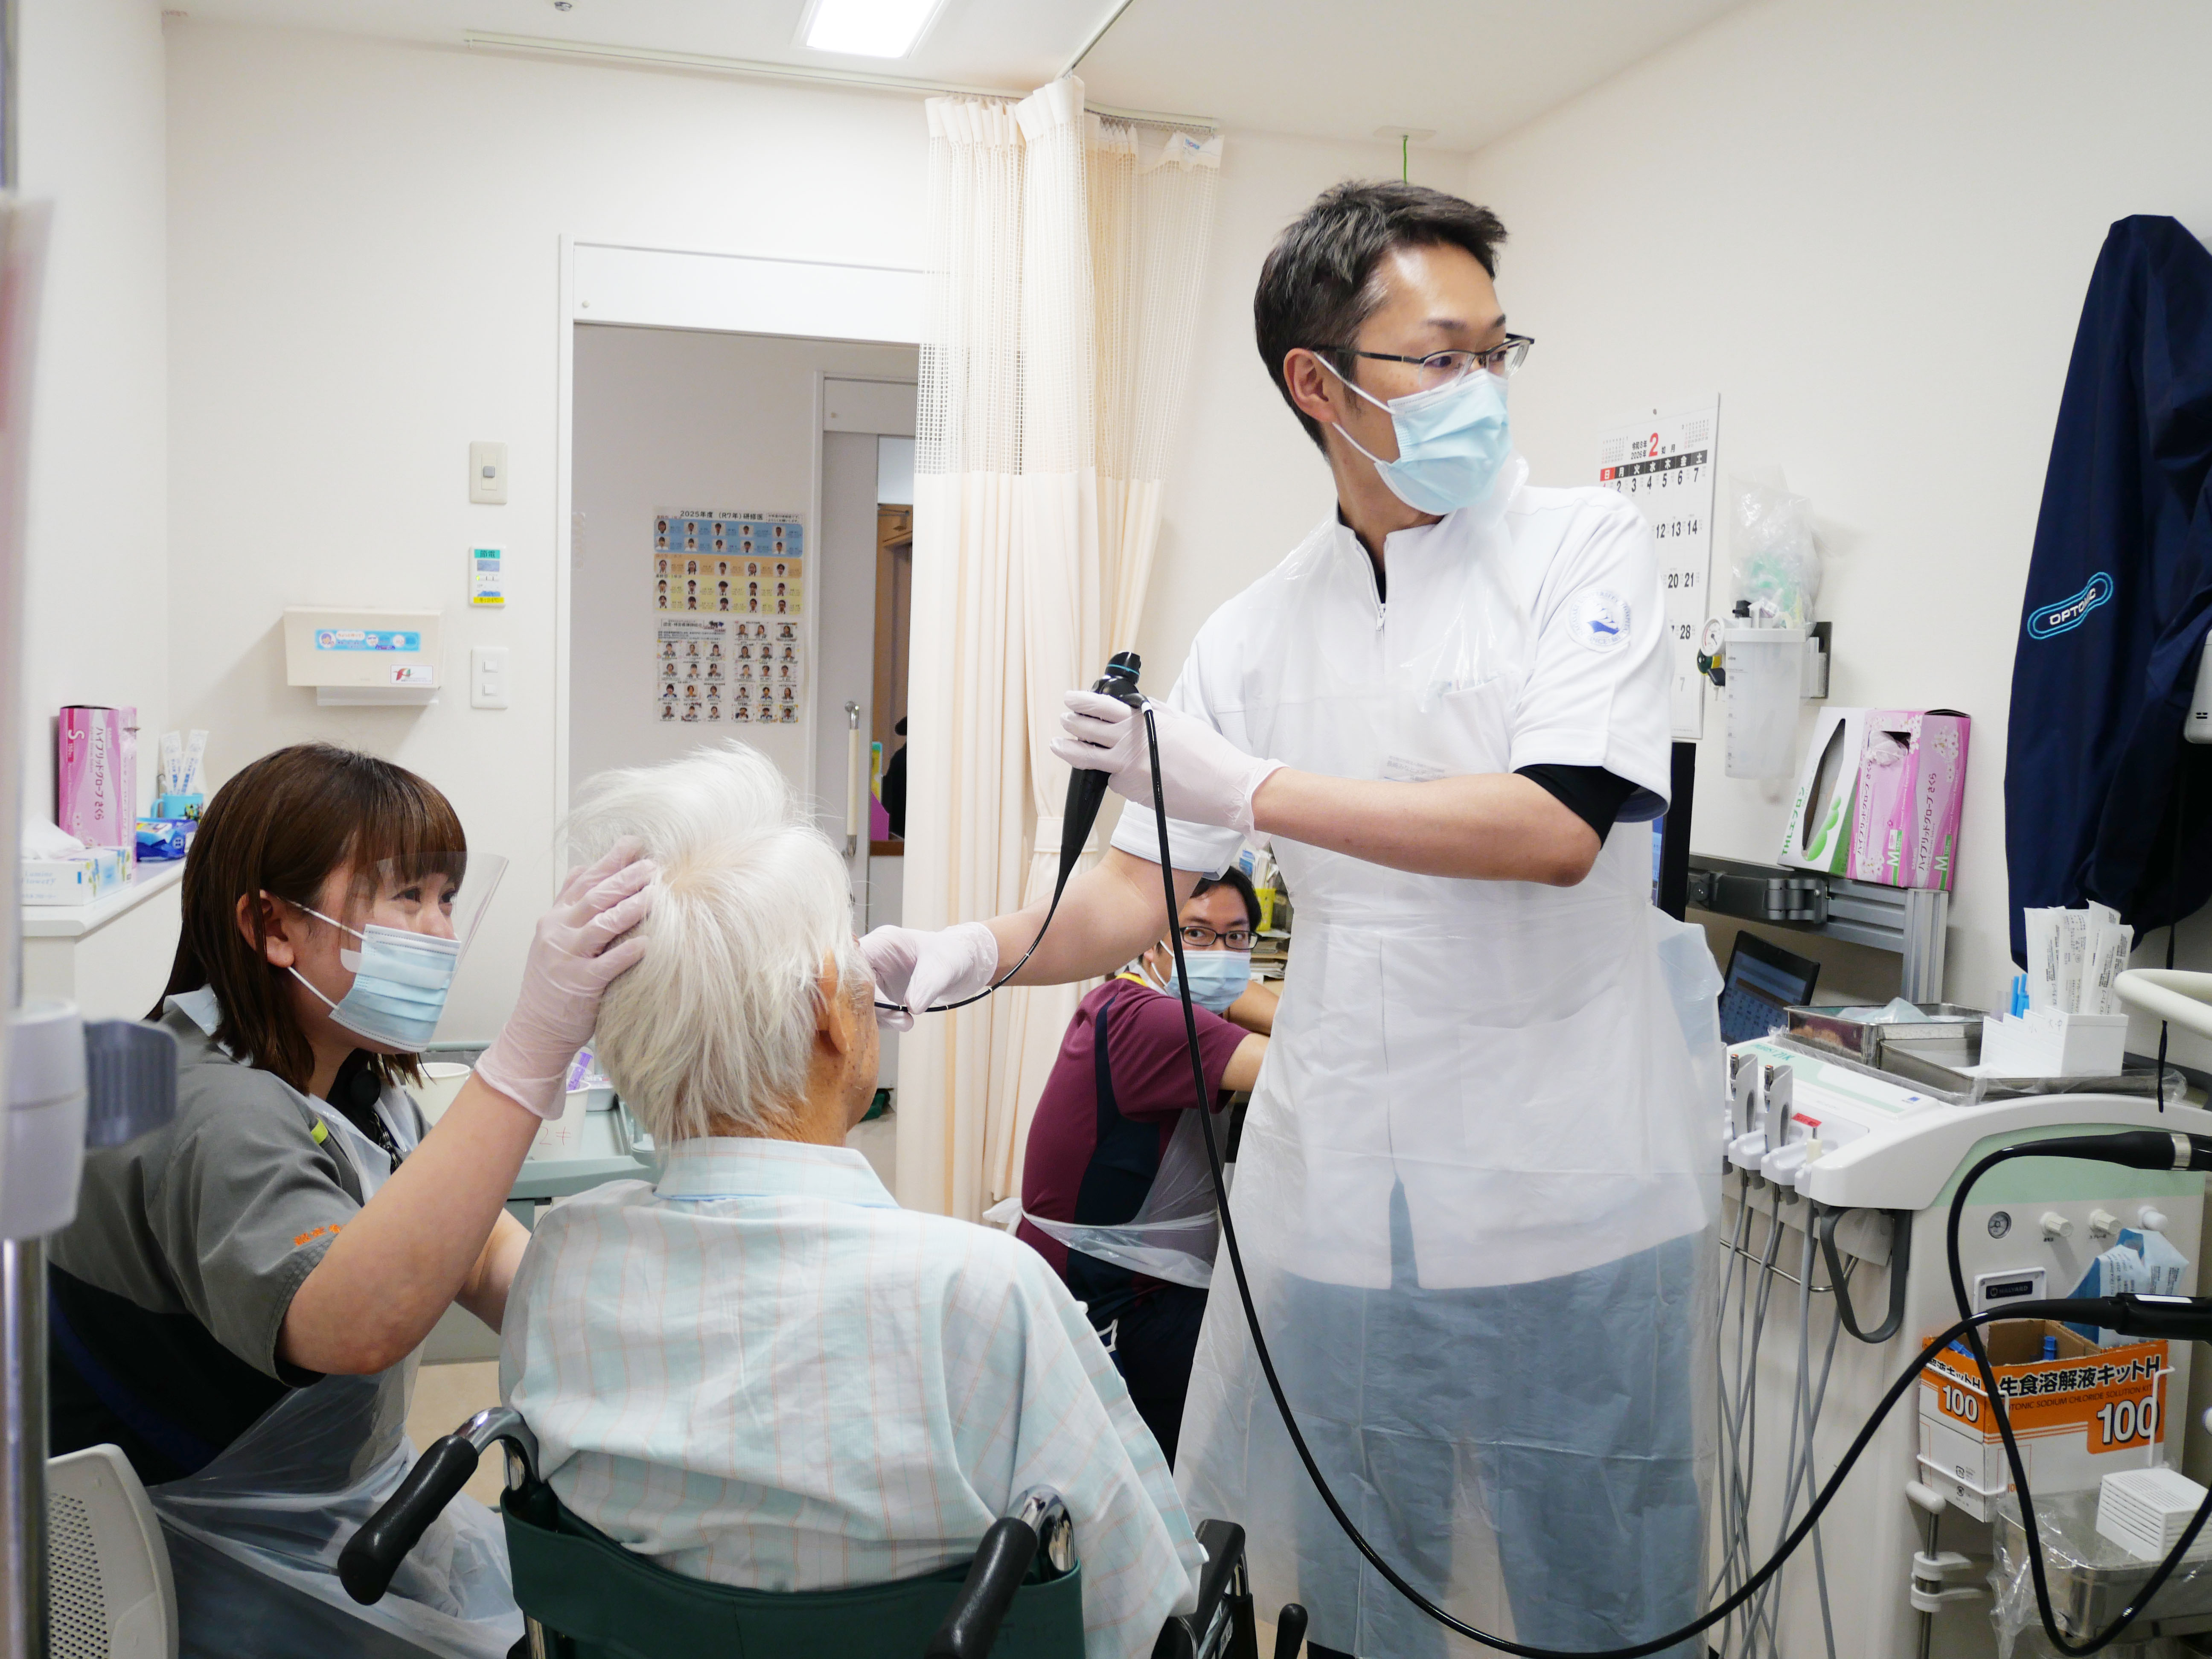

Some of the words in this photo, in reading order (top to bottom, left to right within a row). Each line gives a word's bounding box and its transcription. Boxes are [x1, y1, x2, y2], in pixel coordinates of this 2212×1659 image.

[1632, 440, 1647, 450] 令和8年
[1648, 432, 1659, 457] 2
[1631, 450, 1647, 460] 2026年
[1604, 470, 1610, 479] 日
[1619, 467, 1624, 477] 月
[1633, 464, 1640, 474] 火
[1649, 461, 1656, 472] 水
[1664, 458, 1671, 469] 木
[1680, 455, 1687, 466] 金
[1696, 452, 1703, 464] 土
[1616, 480, 1621, 493] 2
[1631, 478, 1636, 492] 3
[1647, 475, 1652, 490] 4
[1662, 473, 1667, 488] 5
[1678, 470, 1683, 485] 6
[1694, 467, 1699, 482] 7
[680, 510, 713, 518] 2025年度
[1656, 523, 1665, 538] 12
[1672, 521, 1681, 537] 13
[1688, 519, 1697, 535] 14
[1668, 573, 1679, 588] 20
[1684, 572, 1694, 588] 21
[1680, 624, 1691, 640] 28
[1680, 676, 1685, 692] 7
[67, 729, 84, 740] S
[94, 727, 104, 799] ハイブリッドグローブ
[94, 801, 104, 821] さくら
[1857, 783, 1870, 855] ハイブリッドグローブ
[1781, 786, 1805, 856] THLエプロン
[1918, 795, 1933, 870] ハイブリッドグローブ
[1928, 773, 1937, 793] さくら
[1886, 851, 1900, 867] M
[1934, 855, 1949, 871] M
[1999, 1284, 2028, 1293] HALYARD
[2000, 1356, 2160, 1397] 生食溶解液キットH
[1942, 1385, 1979, 1423] 100
[2037, 1397, 2067, 1408] SODIUM
[2069, 1393, 2104, 1404] CHLORIDE
[2106, 1388, 2141, 1398] SOLUTION
[2142, 1385, 2153, 1393] KIT
[2096, 1396, 2160, 1445] 100
[2007, 1483, 2017, 1493] 10
